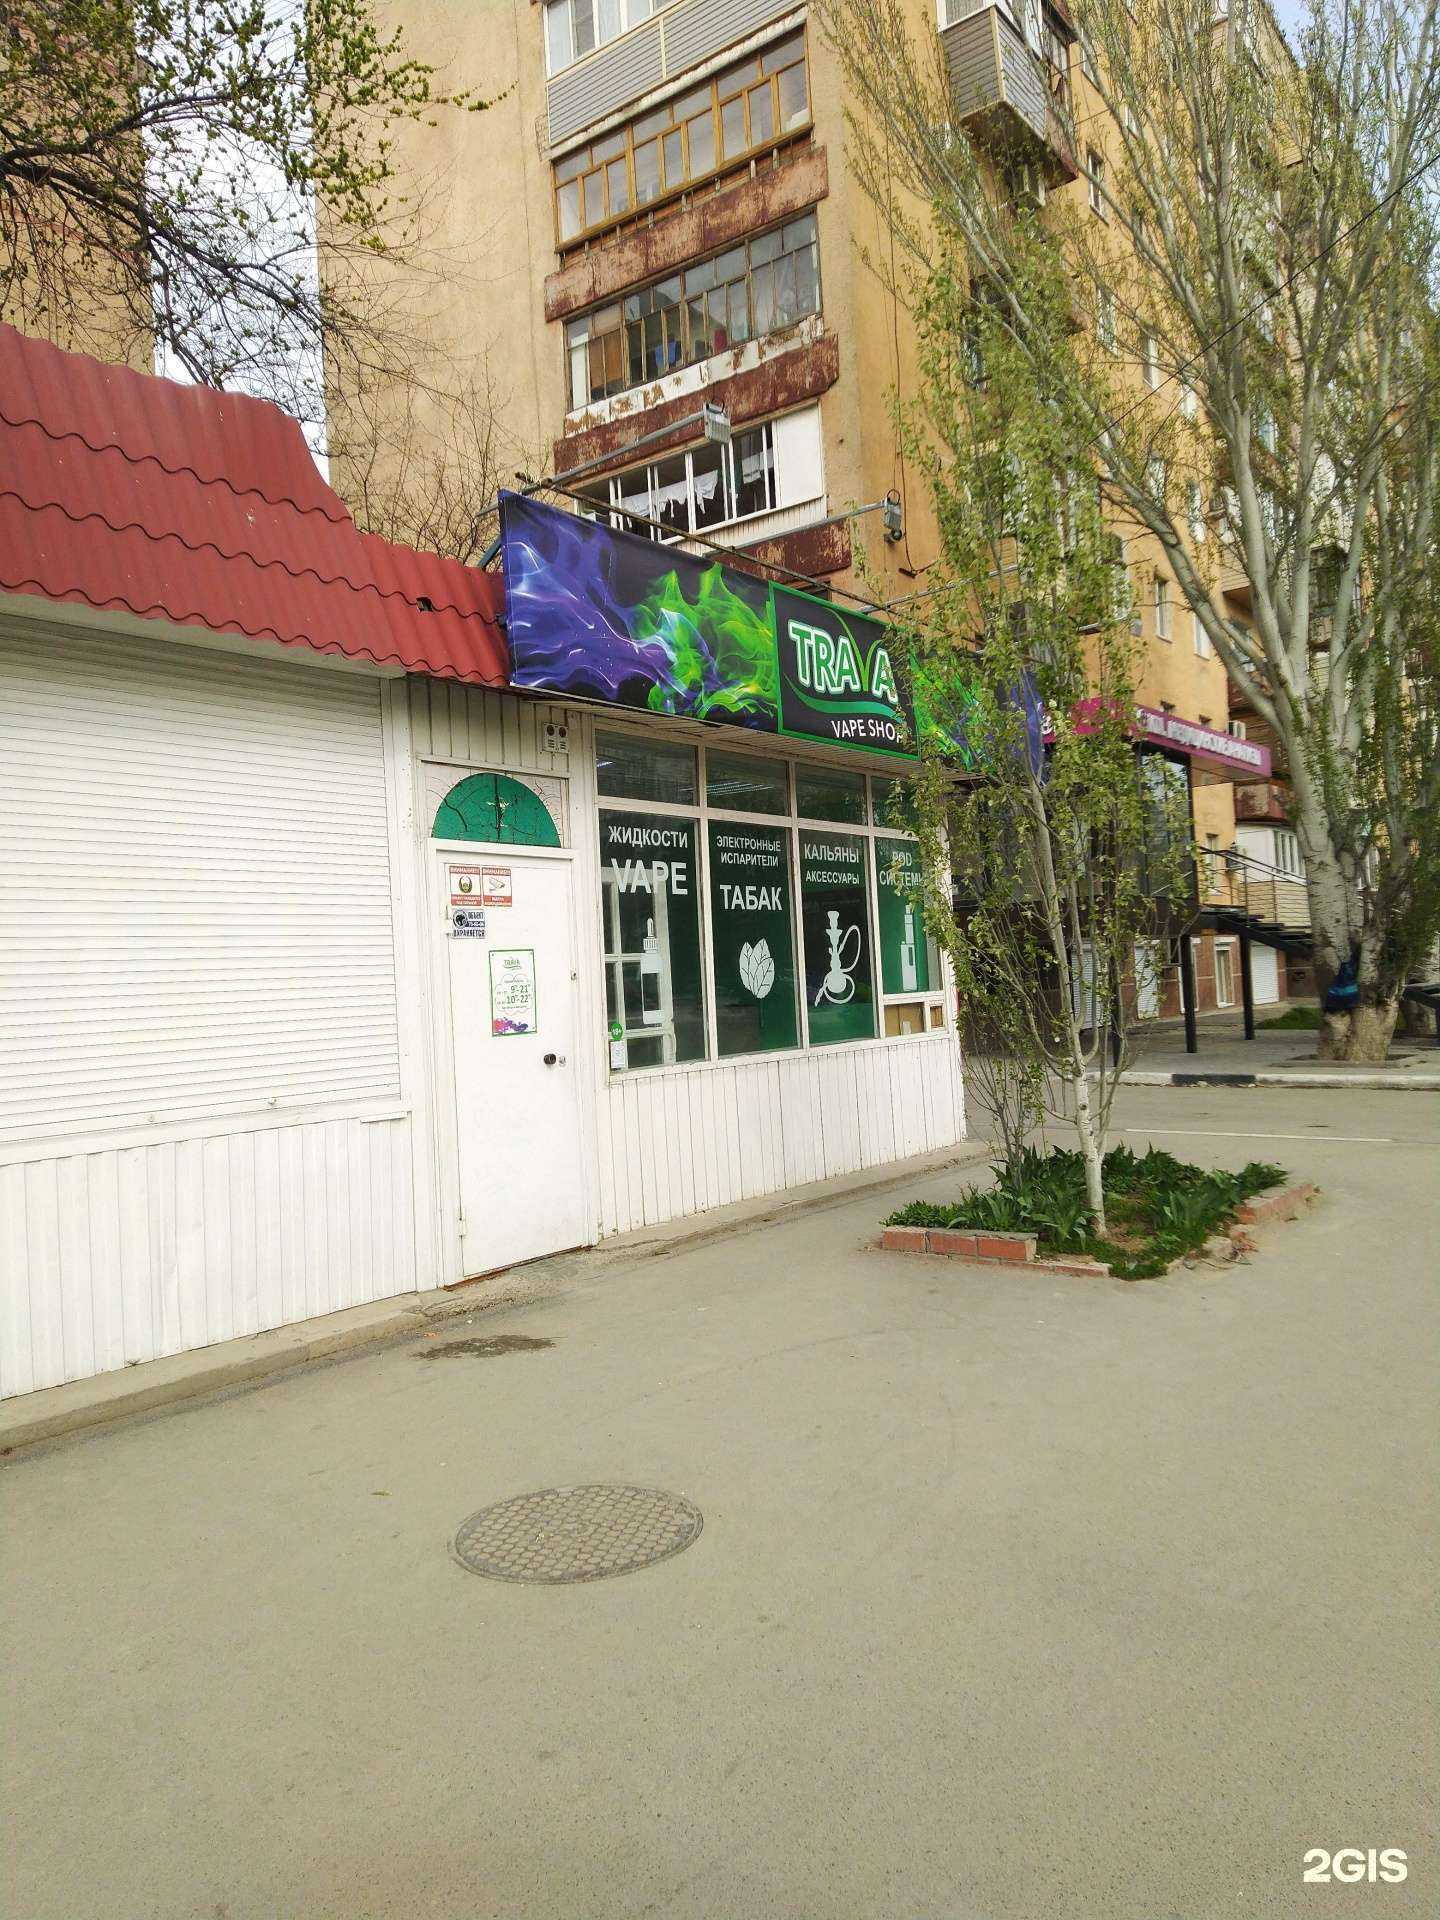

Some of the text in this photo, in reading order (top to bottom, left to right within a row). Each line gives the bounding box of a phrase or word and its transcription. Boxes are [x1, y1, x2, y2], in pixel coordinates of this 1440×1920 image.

[831, 719, 866, 739] VAPE
[608, 825, 688, 849] ЖИДКОСТИ
[716, 835, 781, 852] ЭЛЕКТРОННЫЕ
[720, 852, 779, 867] ИСПАРИТЕЛИ
[804, 843, 860, 863] КАЛЬЯНЫ
[891, 851, 913, 867] POD
[611, 858, 688, 895] VAPE
[805, 870, 860, 885] АКСЕССУАРЫ
[719, 884, 783, 911] ТАБАК
